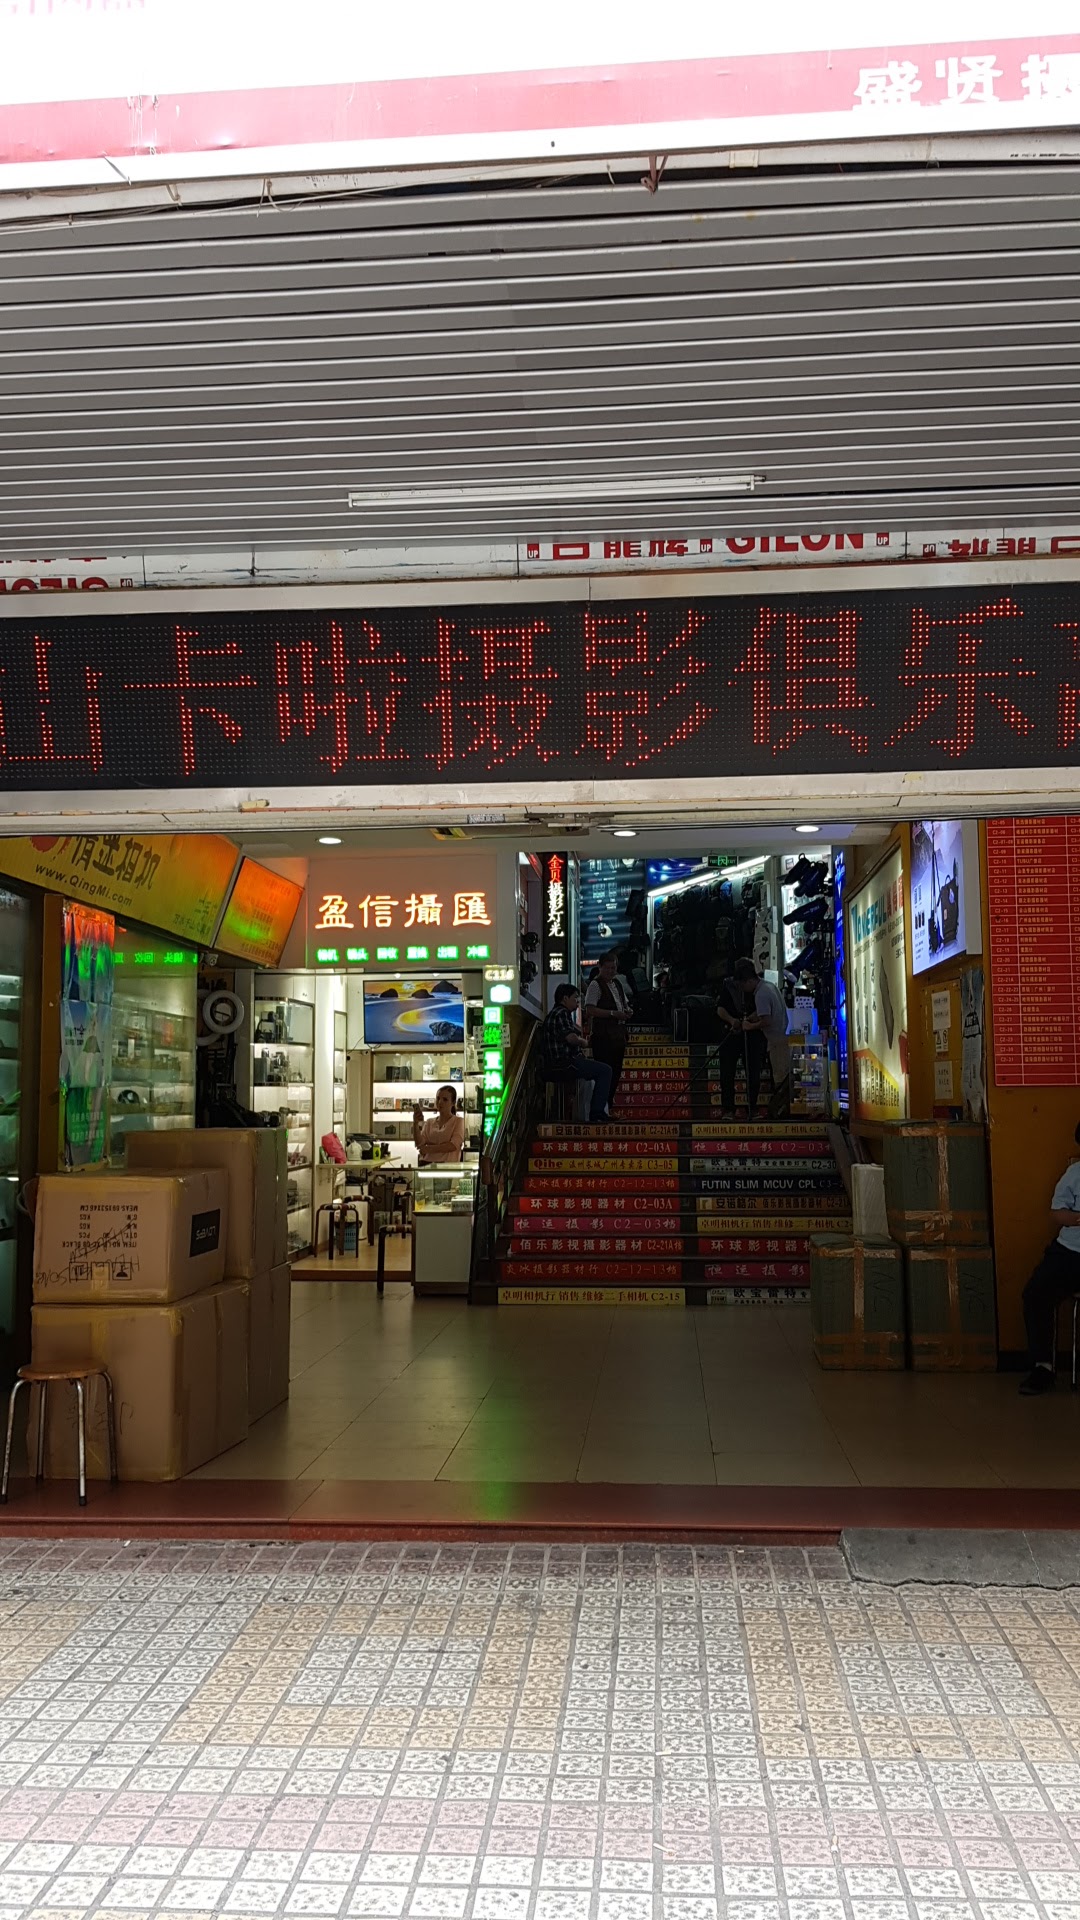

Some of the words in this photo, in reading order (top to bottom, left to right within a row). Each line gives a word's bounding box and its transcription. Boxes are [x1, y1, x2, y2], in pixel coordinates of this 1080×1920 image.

[0, 599, 1080, 776] 山卡啦摄影俱乐
[35, 863, 133, 906] www.QingMi.com
[315, 892, 491, 929] 盈信攝匯
[810, 1126, 828, 1134] C2-1
[543, 1142, 629, 1152] 环球影视器材
[636, 1142, 671, 1153] C2-03A
[533, 1160, 563, 1170] Qihe
[647, 1160, 673, 1170] C3-05
[811, 1161, 837, 1170] C2-30
[701, 1180, 730, 1189] FUTIN
[735, 1180, 759, 1189] SLIM
[763, 1179, 794, 1189] MCUV
[798, 1179, 817, 1189] CPL
[530, 1198, 626, 1209] 环球影视器材
[633, 1198, 673, 1209] C2-03A
[836, 1219, 852, 1229] C2-
[519, 1238, 643, 1251] 佰乐影视摄影器材
[651, 1290, 680, 1301] C2-15
